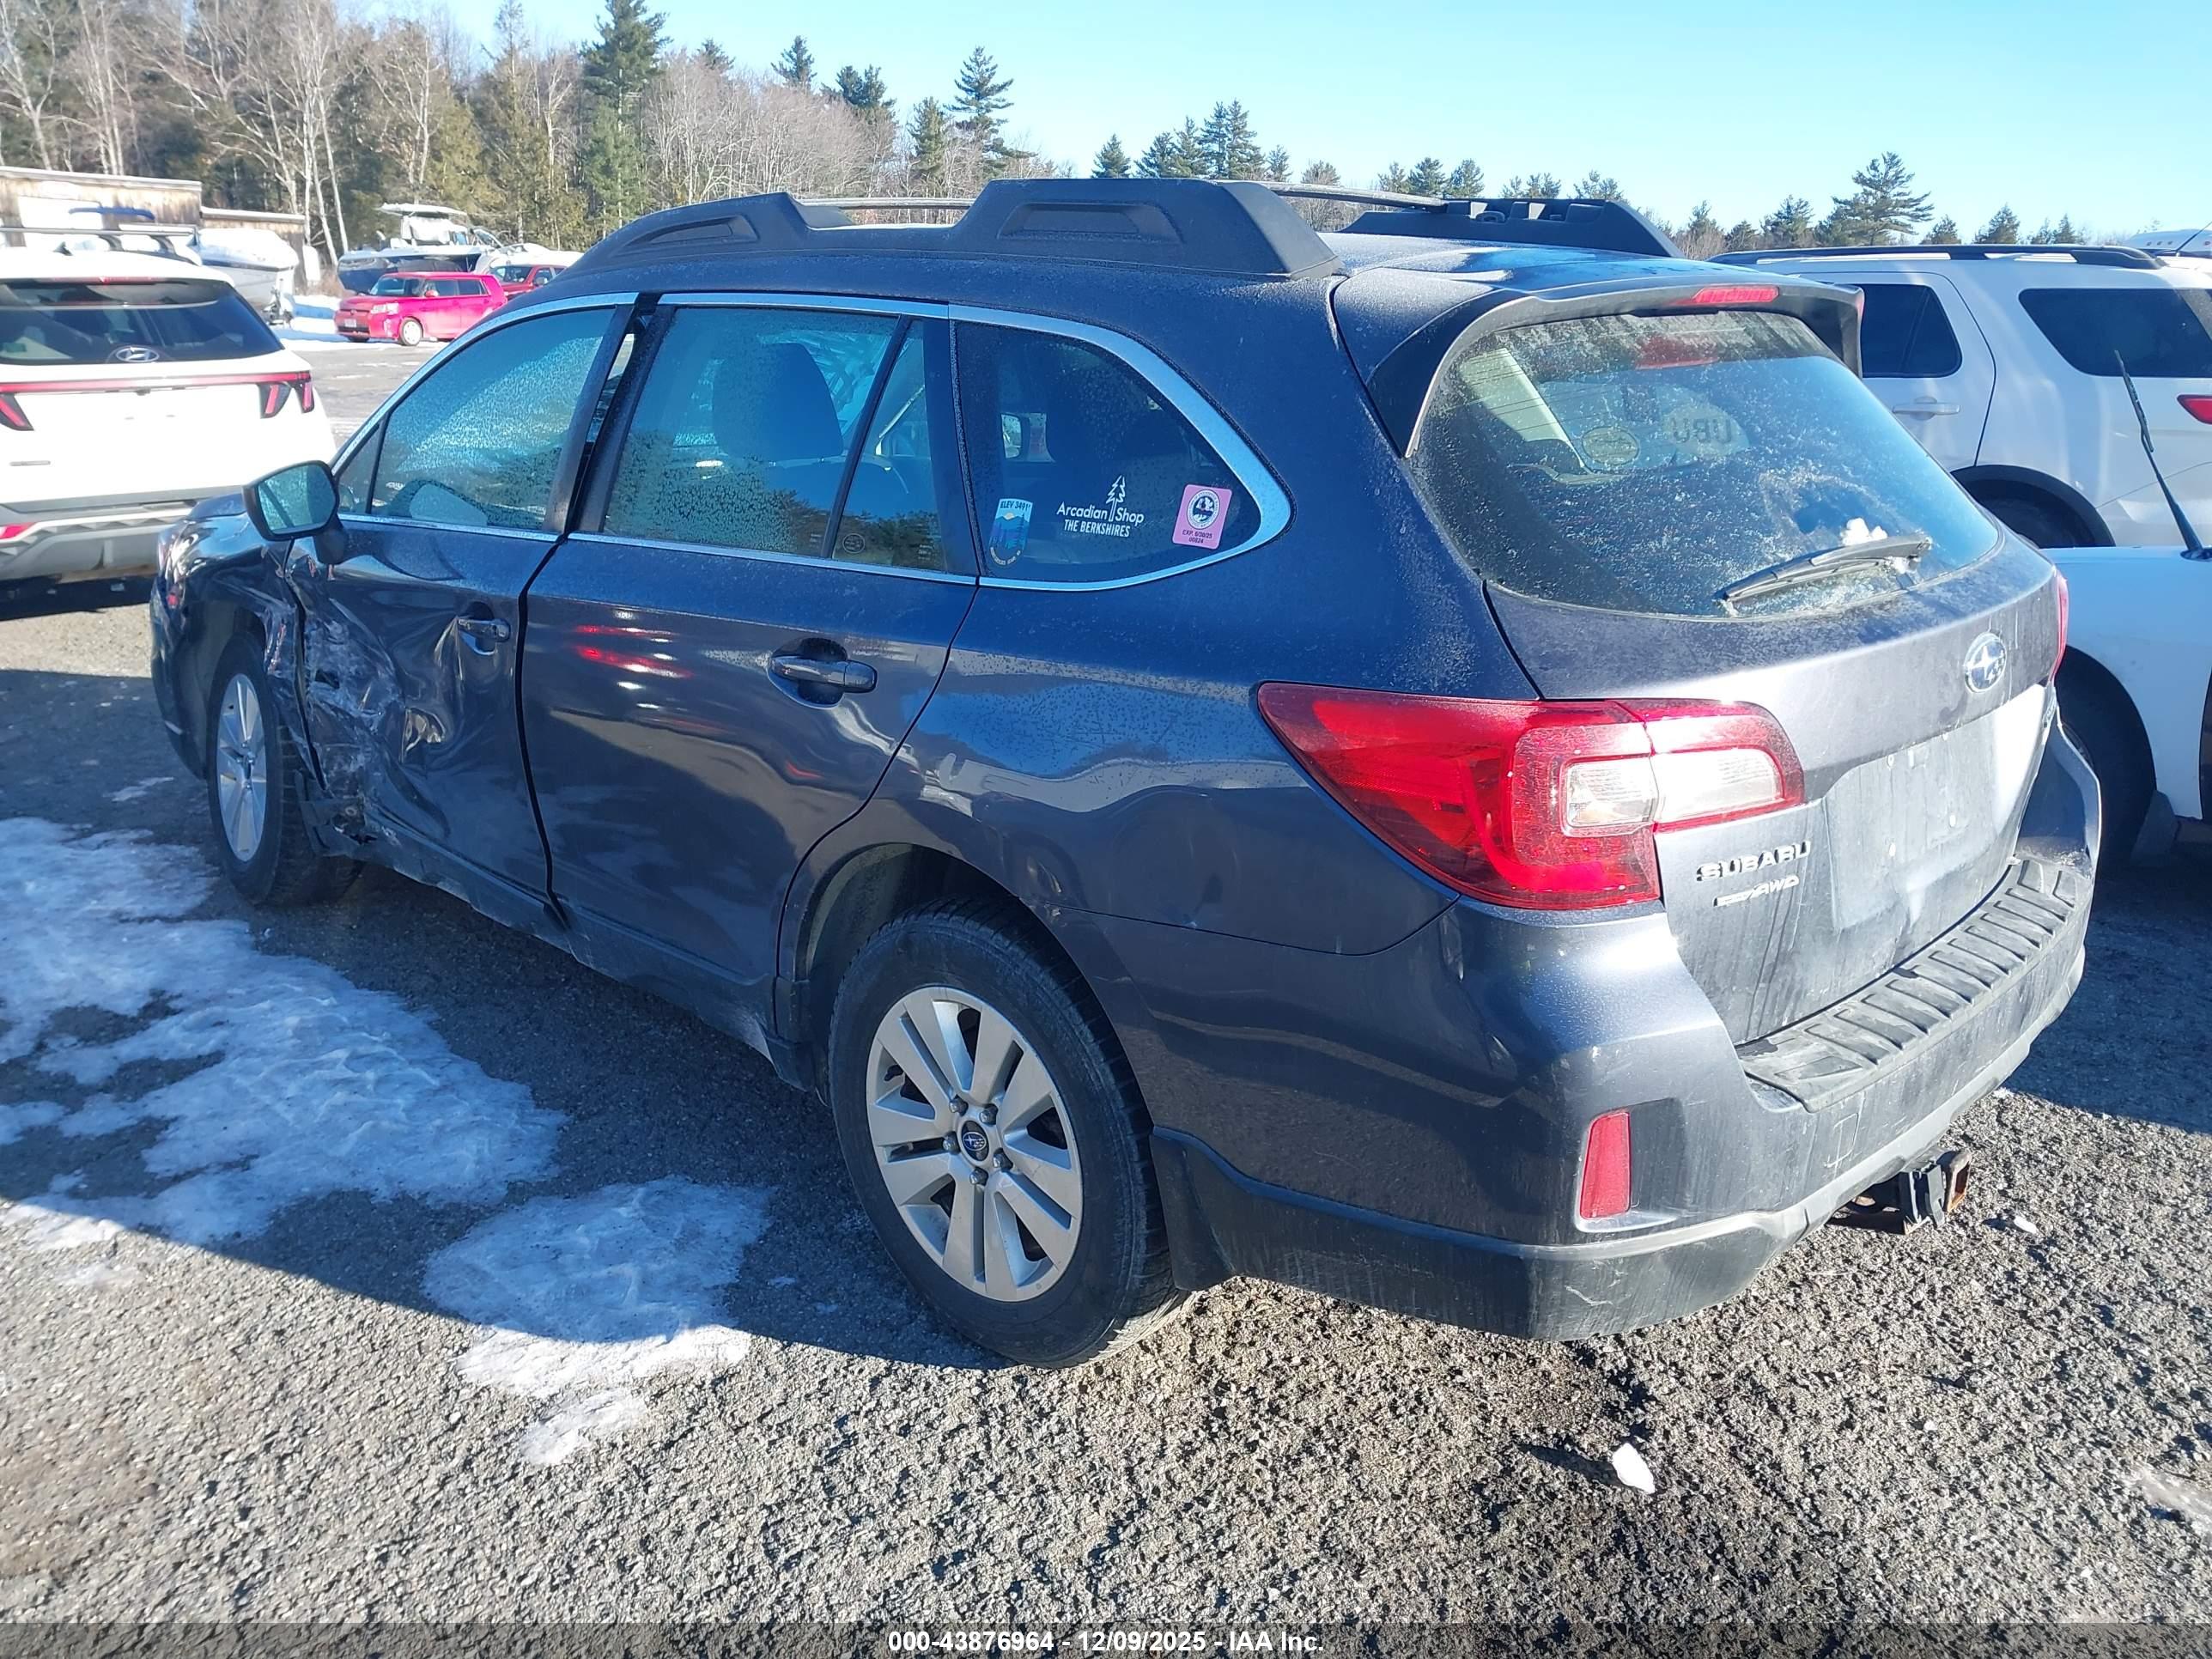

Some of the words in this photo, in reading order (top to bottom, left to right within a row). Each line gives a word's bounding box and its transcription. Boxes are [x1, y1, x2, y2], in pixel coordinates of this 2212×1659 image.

[1056, 501, 1108, 520] Arcadian
[1115, 507, 1145, 526] Shop
[1064, 519, 1079, 532] THE
[1079, 520, 1131, 538] BERKSHIRES
[1697, 840, 1811, 882] SUBARU
[1753, 874, 1800, 897] AWD
